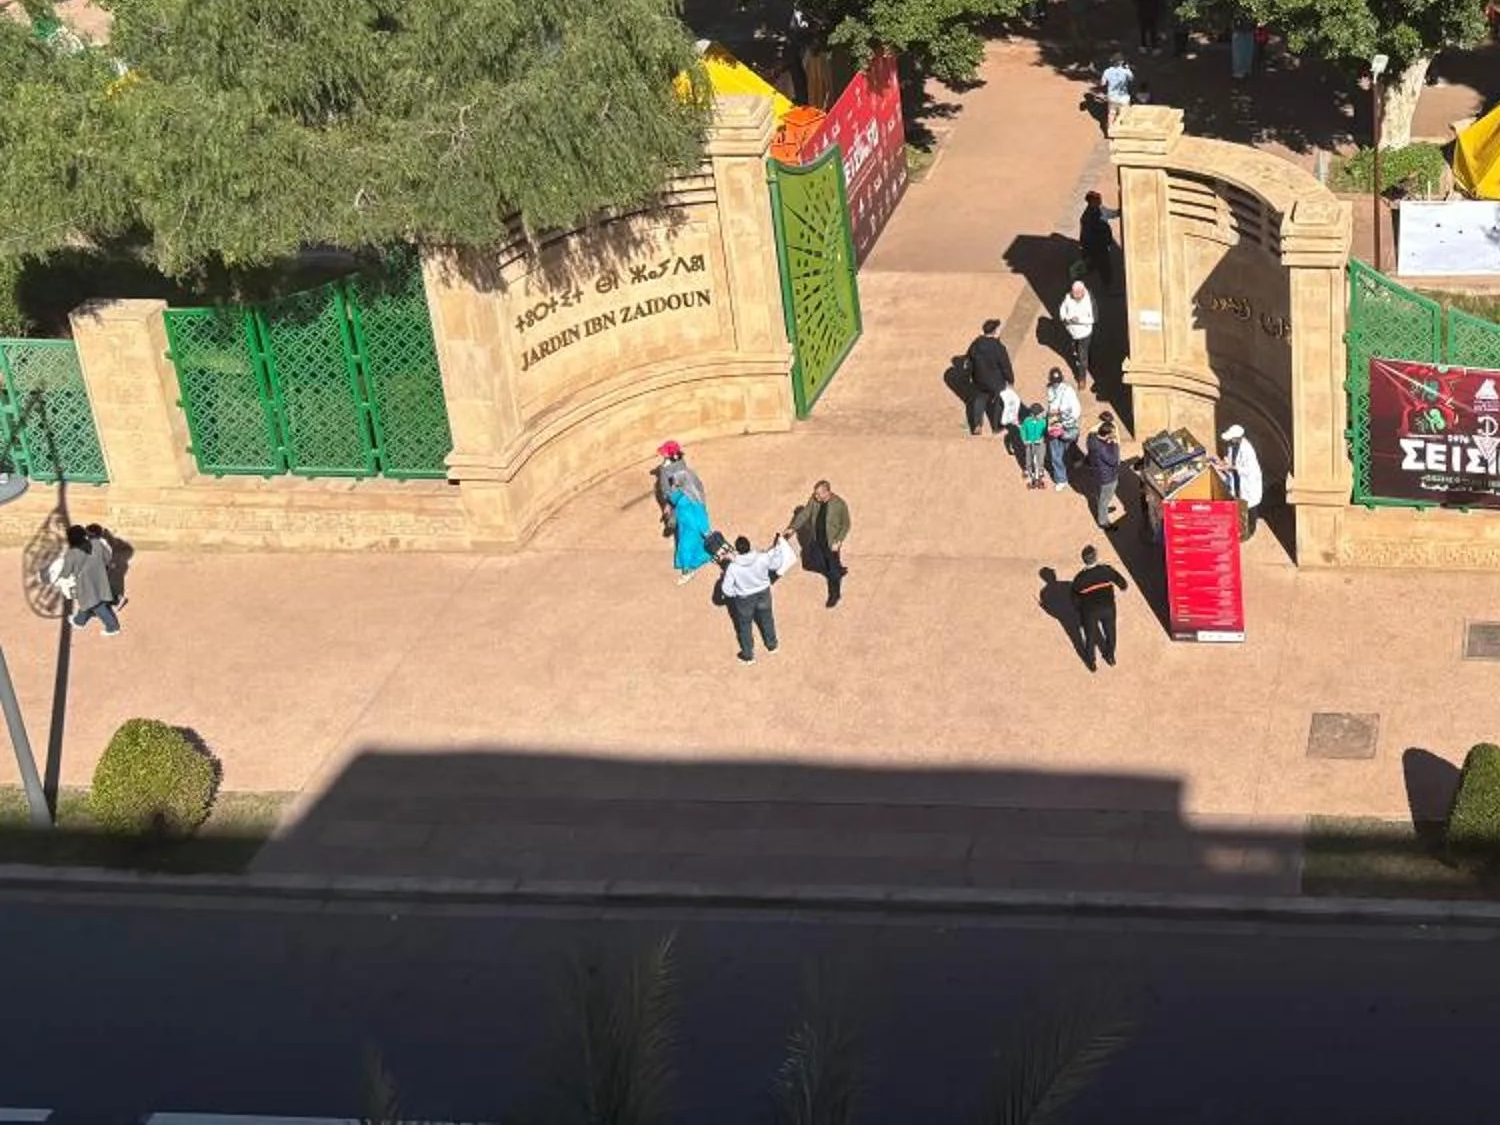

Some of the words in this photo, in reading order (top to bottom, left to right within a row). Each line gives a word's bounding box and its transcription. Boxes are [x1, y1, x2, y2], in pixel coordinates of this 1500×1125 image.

[521, 324, 581, 371] JARDIN
[584, 311, 617, 338] IBN
[620, 289, 711, 324] ZAIDOUN
